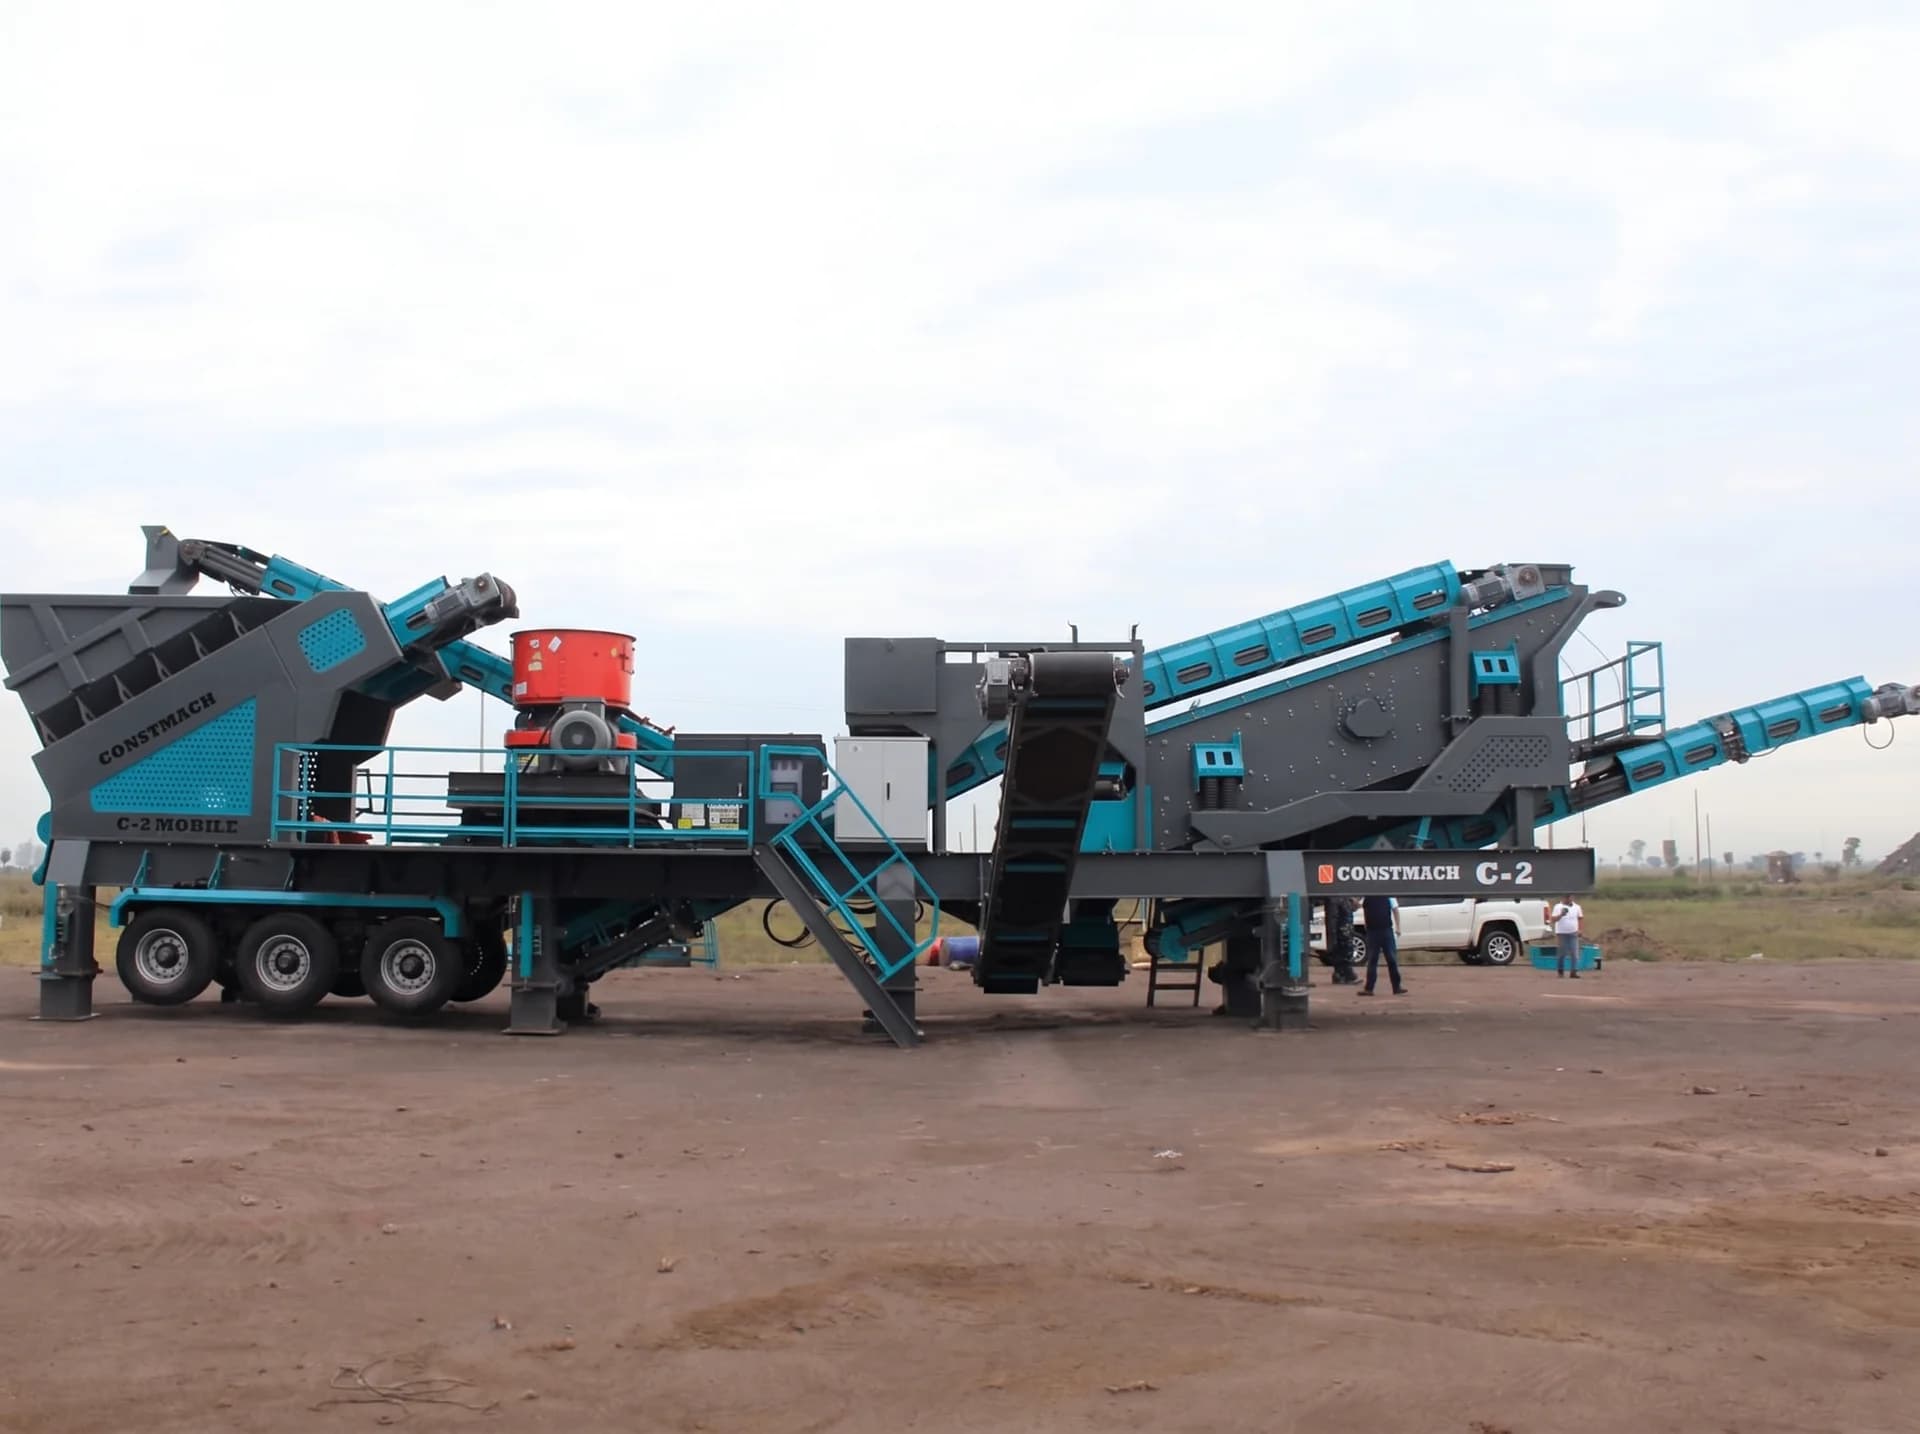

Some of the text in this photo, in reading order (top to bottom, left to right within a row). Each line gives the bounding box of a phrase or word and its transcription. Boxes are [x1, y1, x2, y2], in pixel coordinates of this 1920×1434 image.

[98, 692, 217, 765] CONSTMACH
[116, 817, 238, 833] C-2 MOBILE
[1337, 862, 1533, 885] CONSTMACH C-2
